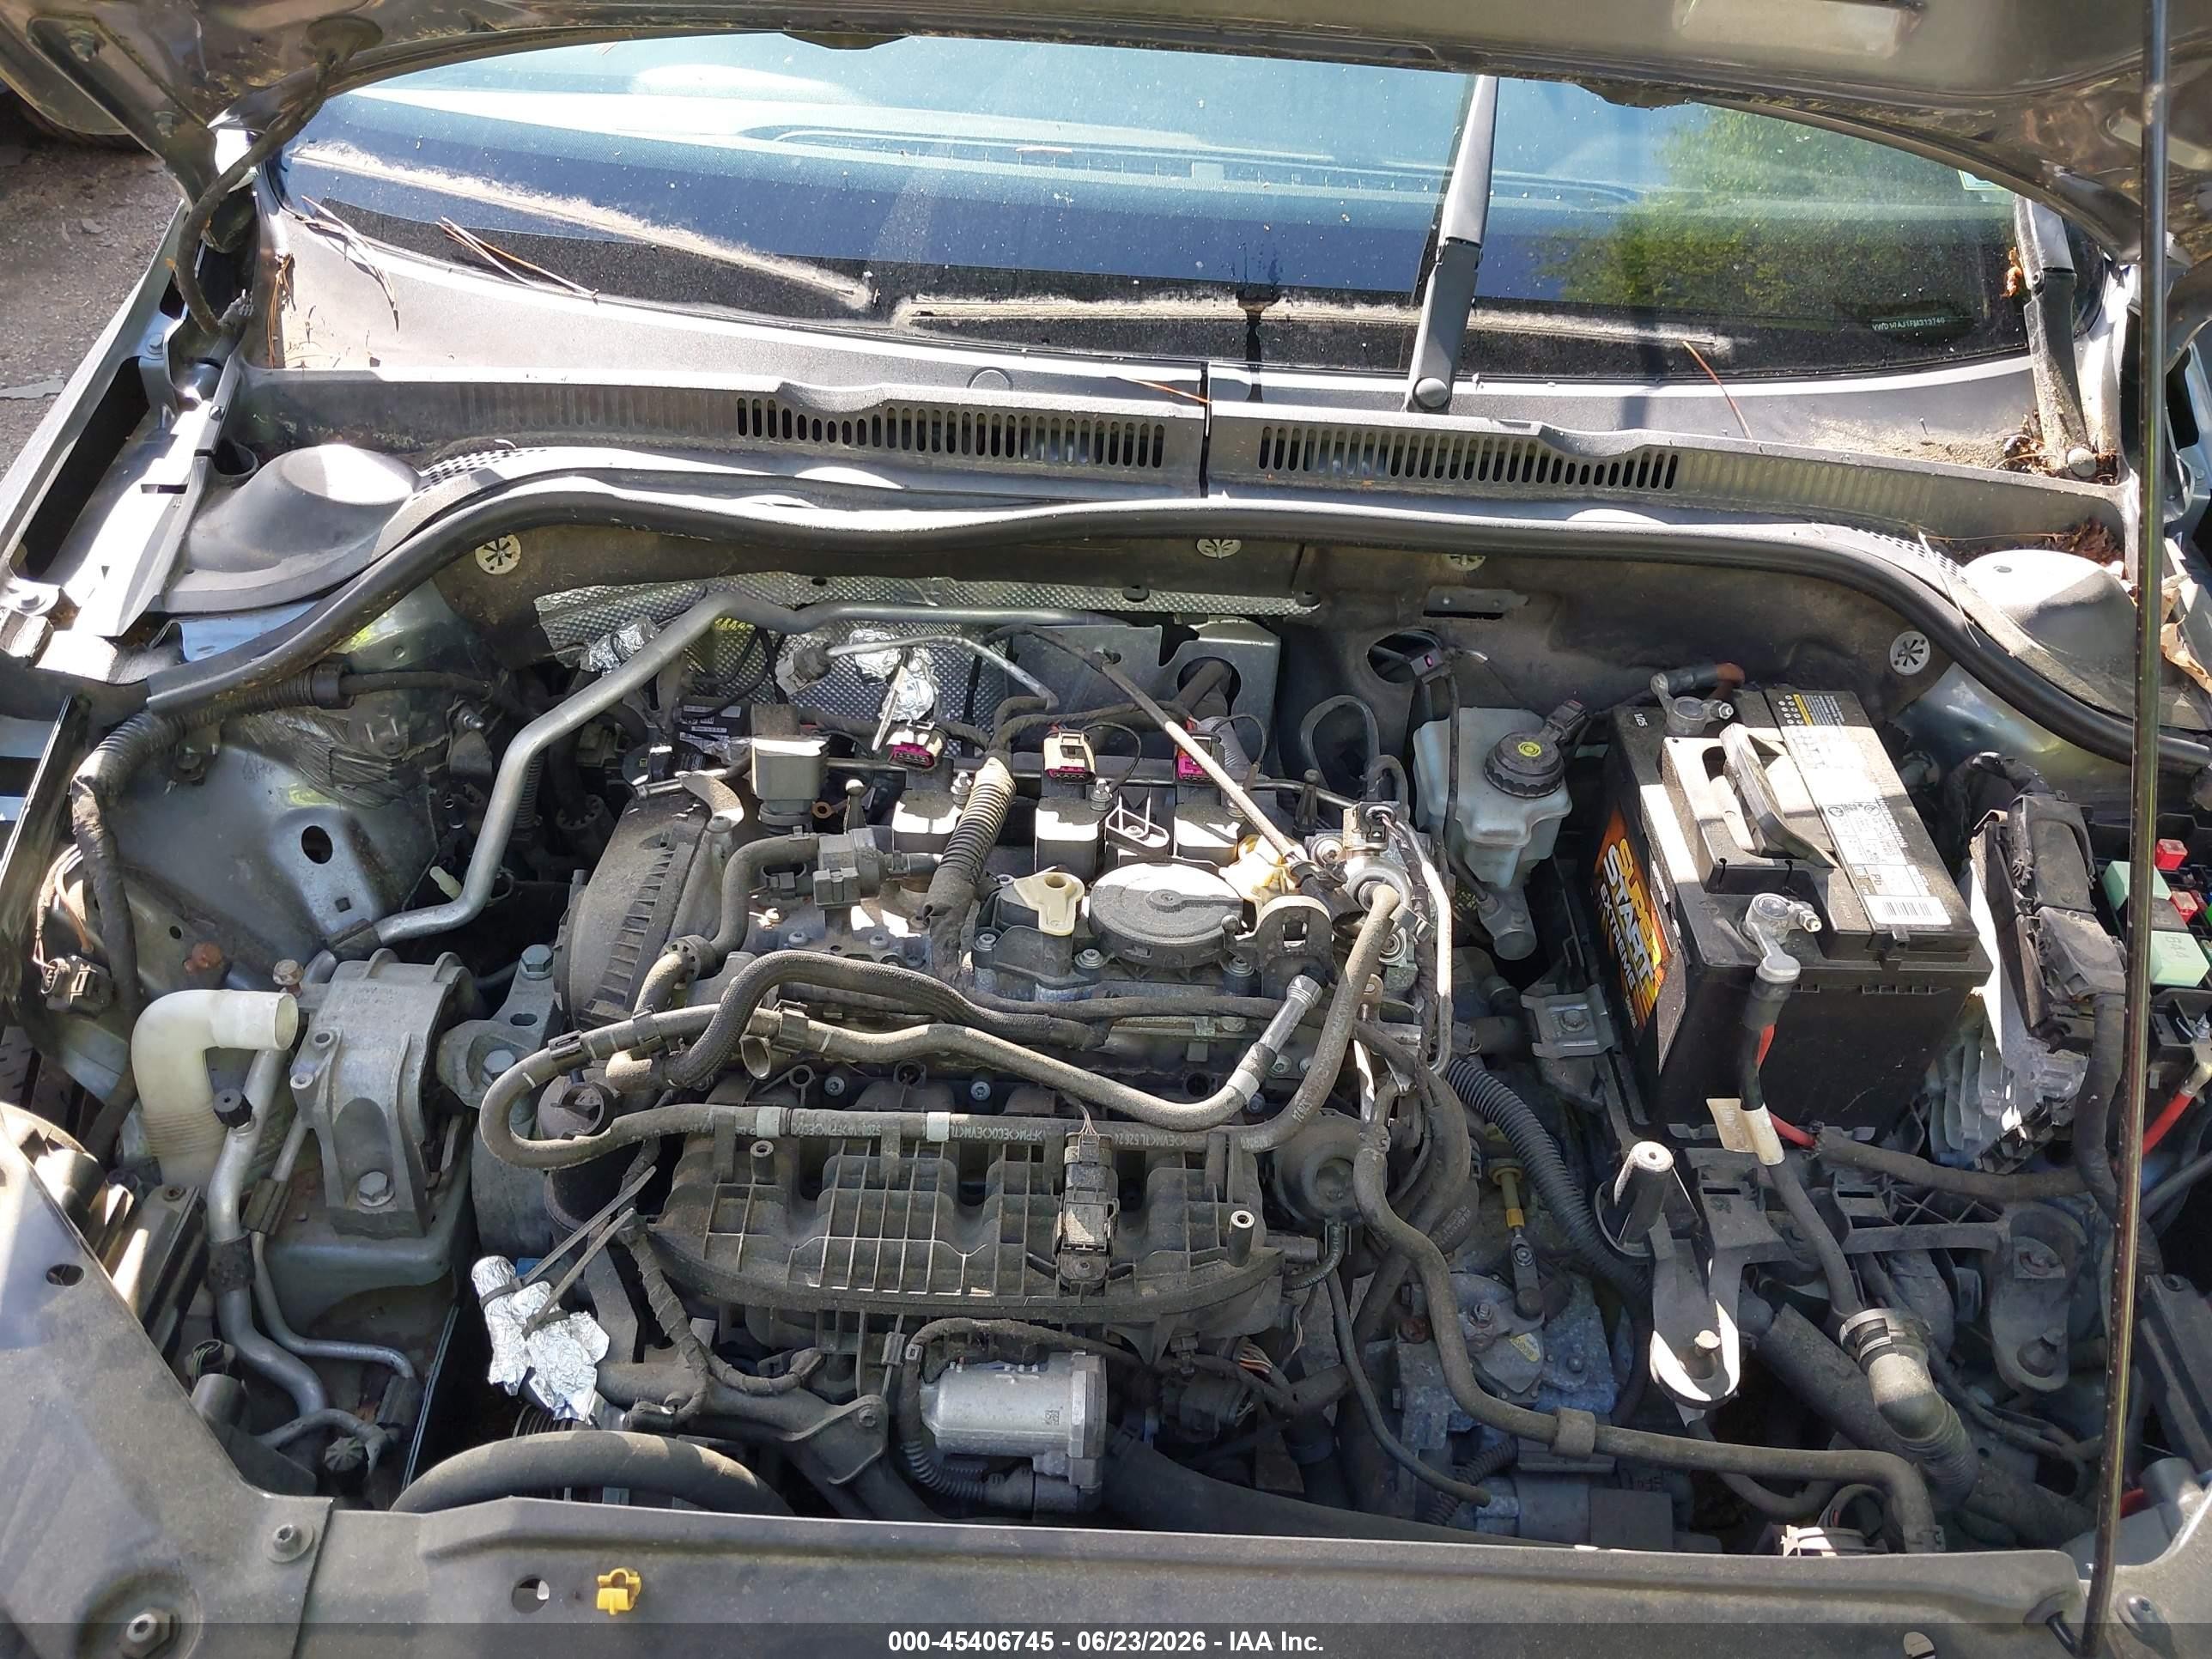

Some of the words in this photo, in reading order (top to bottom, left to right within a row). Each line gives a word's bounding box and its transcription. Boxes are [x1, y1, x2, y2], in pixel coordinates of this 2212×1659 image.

[1633, 713, 1649, 727] 1/25
[1600, 883, 1637, 990] EXTREME
[1603, 844, 1654, 984] START
[1619, 837, 1662, 969] SUPER
